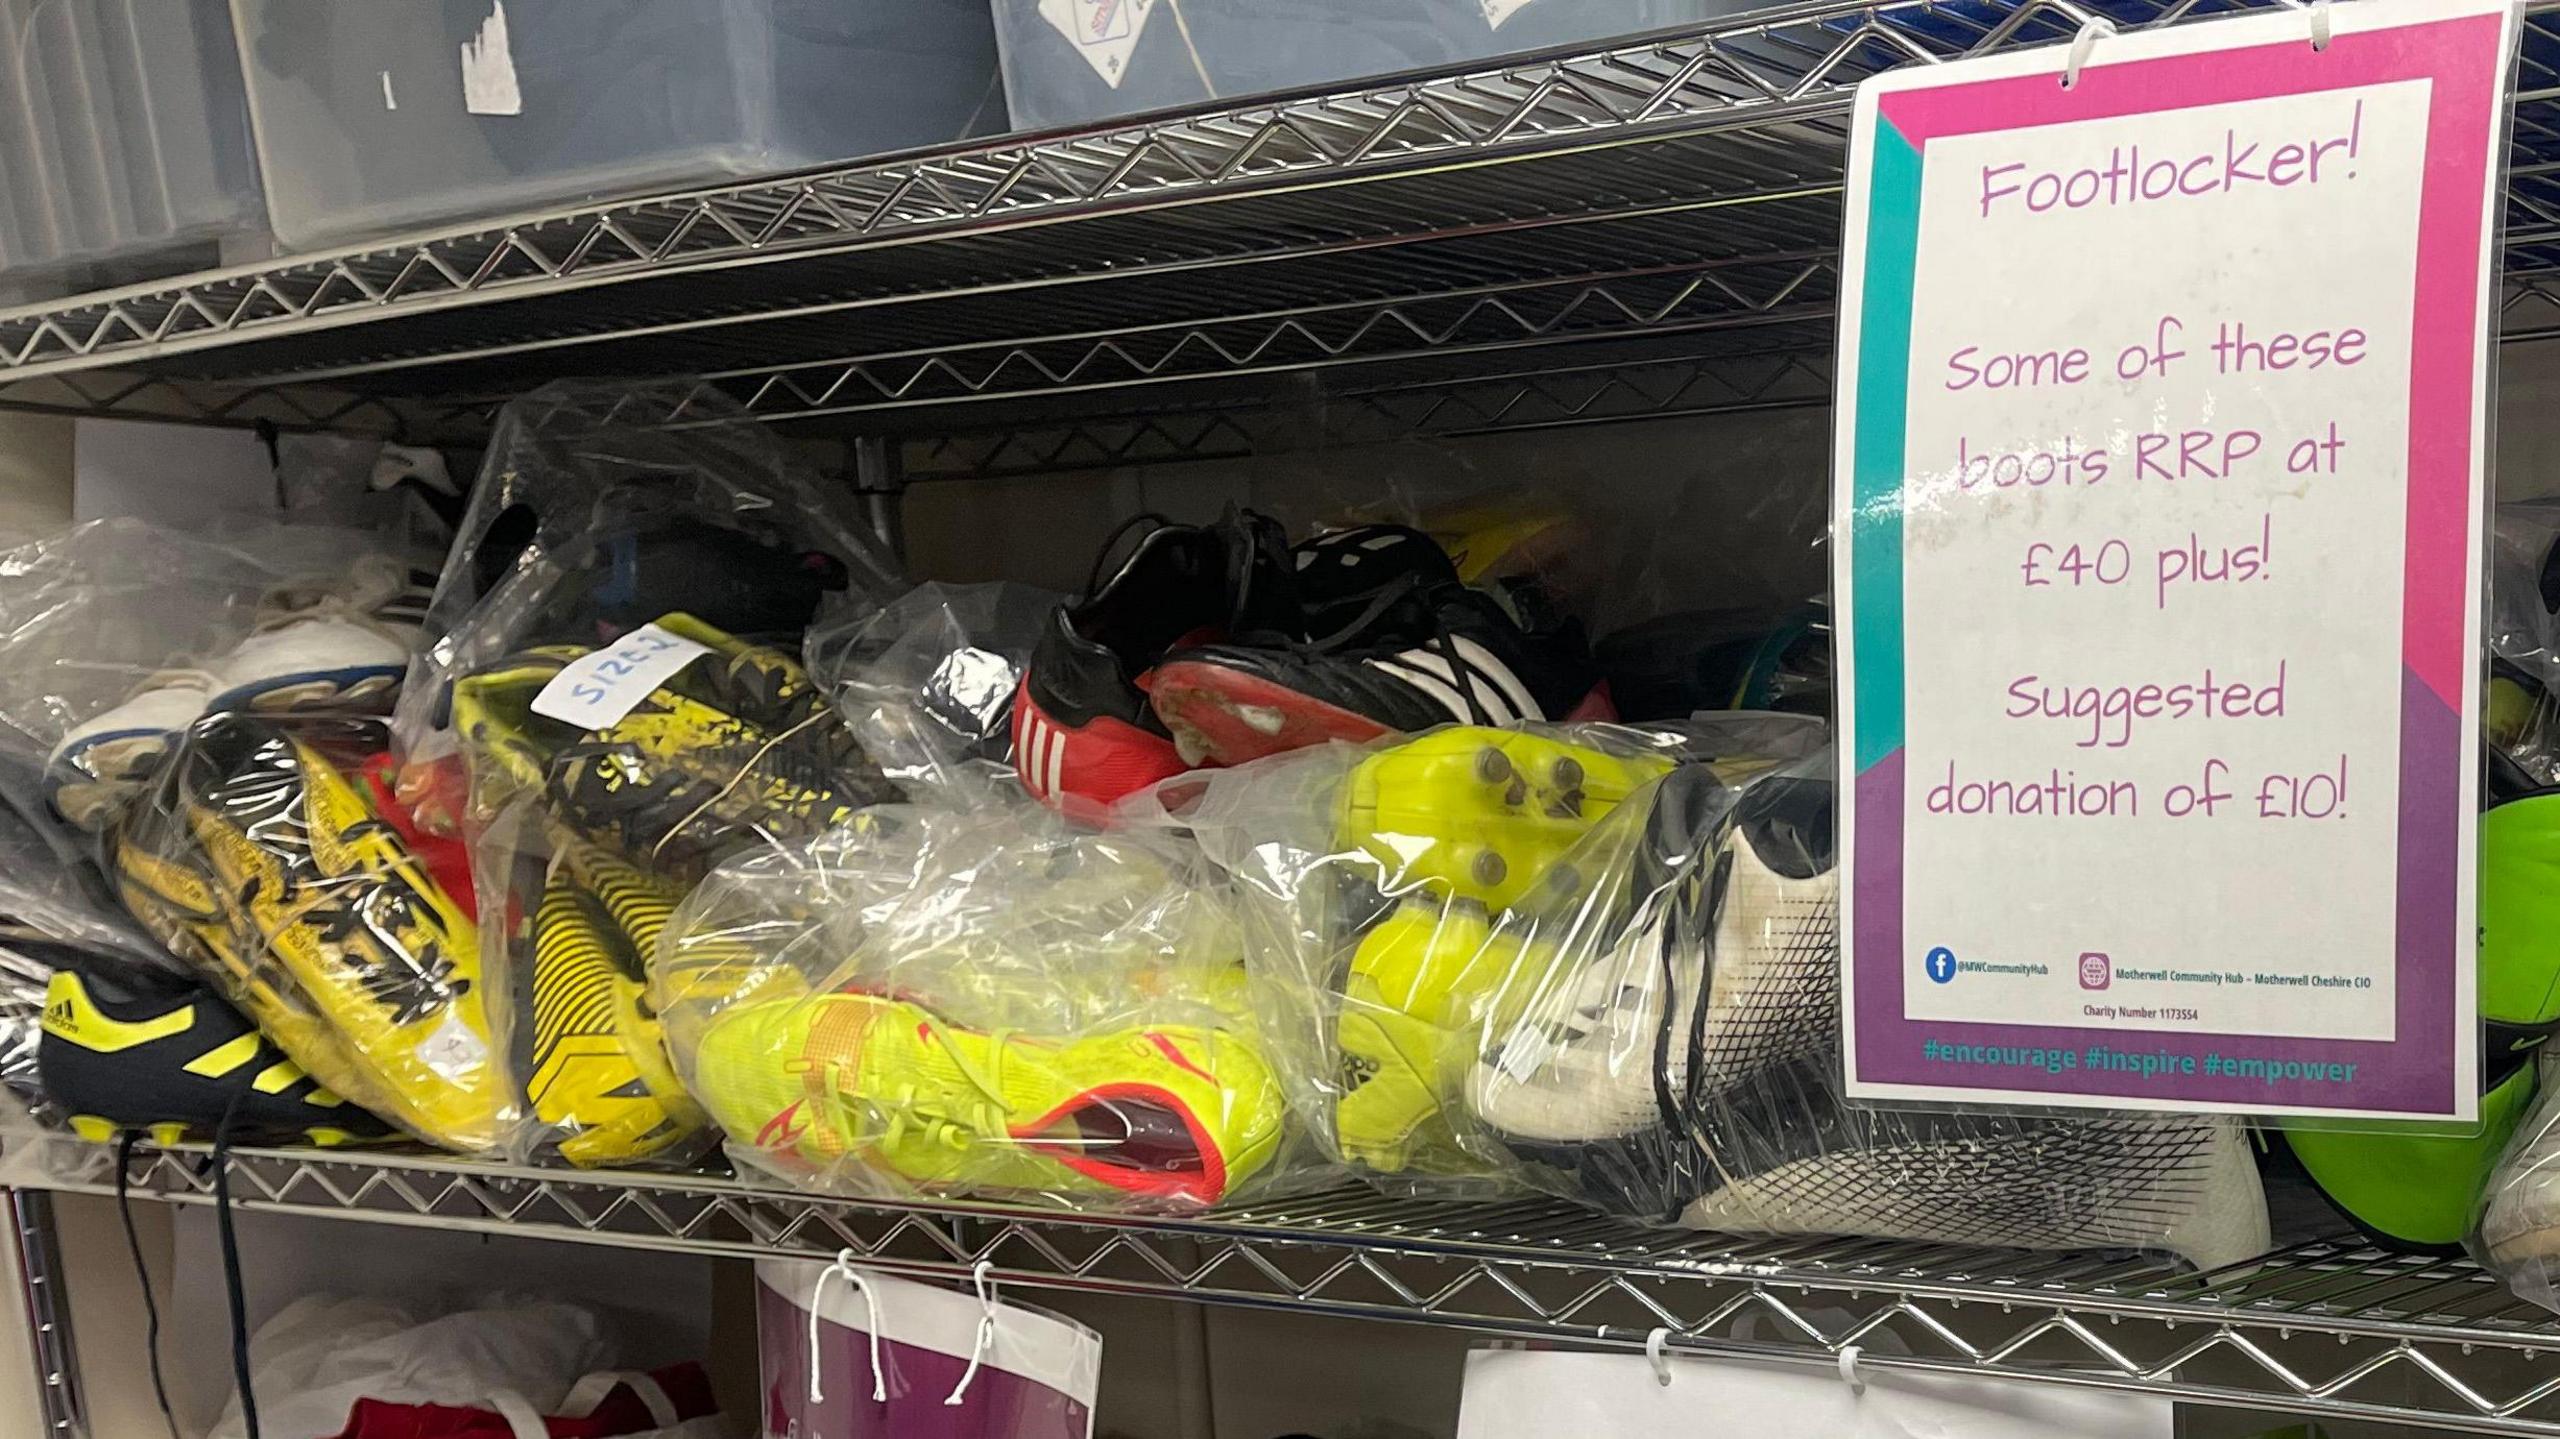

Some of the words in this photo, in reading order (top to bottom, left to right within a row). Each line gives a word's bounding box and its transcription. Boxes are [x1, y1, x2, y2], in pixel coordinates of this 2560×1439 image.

[1980, 99, 2362, 218] Footlocker!
[1945, 347, 2089, 391] Some
[2117, 316, 2186, 380] of
[2210, 322, 2366, 374] these
[1960, 436, 2108, 488] boots
[2136, 430, 2261, 480] RRP
[2287, 421, 2345, 473] at
[2021, 540, 2130, 586] £40
[2159, 513, 2270, 609] plus!
[2006, 659, 2285, 748] Suggested
[1927, 759, 2136, 816] donation
[2164, 759, 2232, 817] of
[2255, 753, 2347, 819] £10!
[1957, 960, 2049, 978] @MWCommunityHub
[2115, 967, 2168, 982] Motherwell
[2169, 969, 2223, 987] Community
[2224, 971, 2245, 985] Hub
[2254, 972, 2310, 987] Motherwell
[2311, 975, 2352, 989] Cheshire
[2353, 976, 2372, 989] CIO
[2083, 1004, 2117, 1020] Charity
[2118, 1005, 2158, 1020] Number
[2159, 1007, 2199, 1021] 1173554
[1924, 1038, 2077, 1073] #encourage
[2085, 1046, 2197, 1079] #inspire
[2203, 1052, 2358, 1085] #empower
